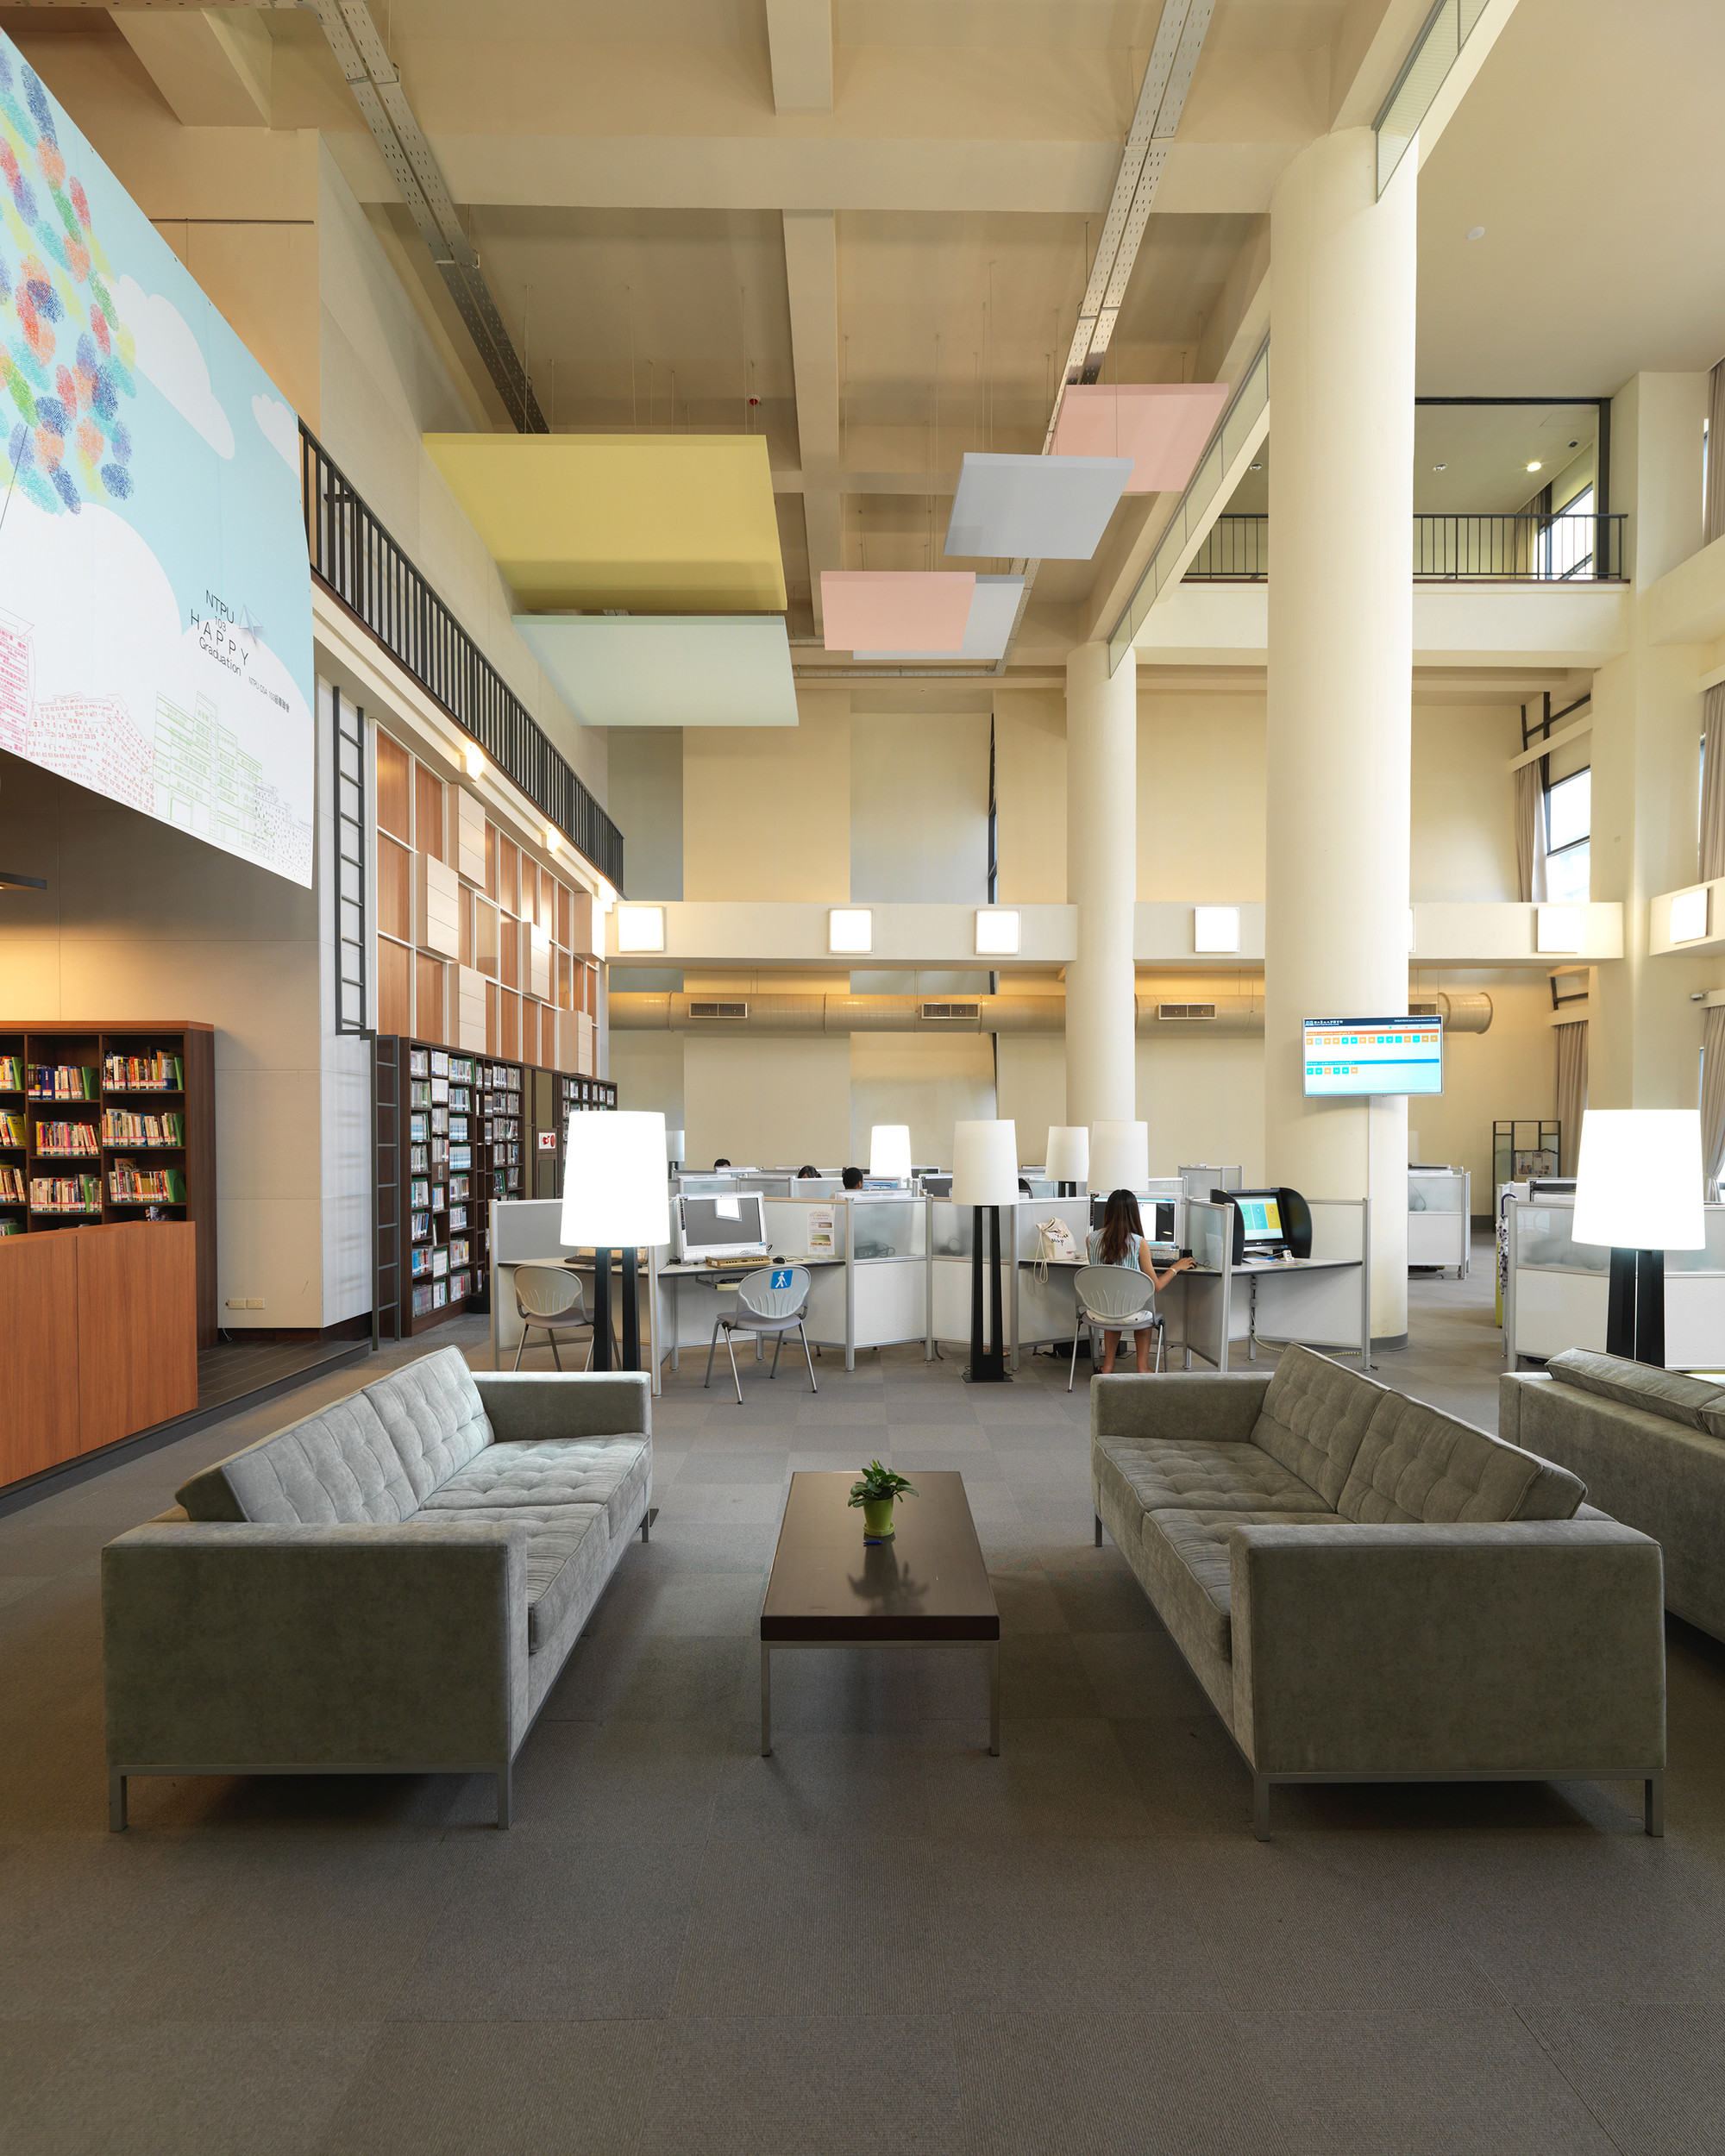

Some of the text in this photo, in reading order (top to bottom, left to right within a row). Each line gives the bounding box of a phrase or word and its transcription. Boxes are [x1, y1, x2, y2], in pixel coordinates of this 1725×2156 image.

[206, 590, 235, 624] NTPU
[215, 616, 227, 631] 103
[199, 636, 242, 676] Graduation
